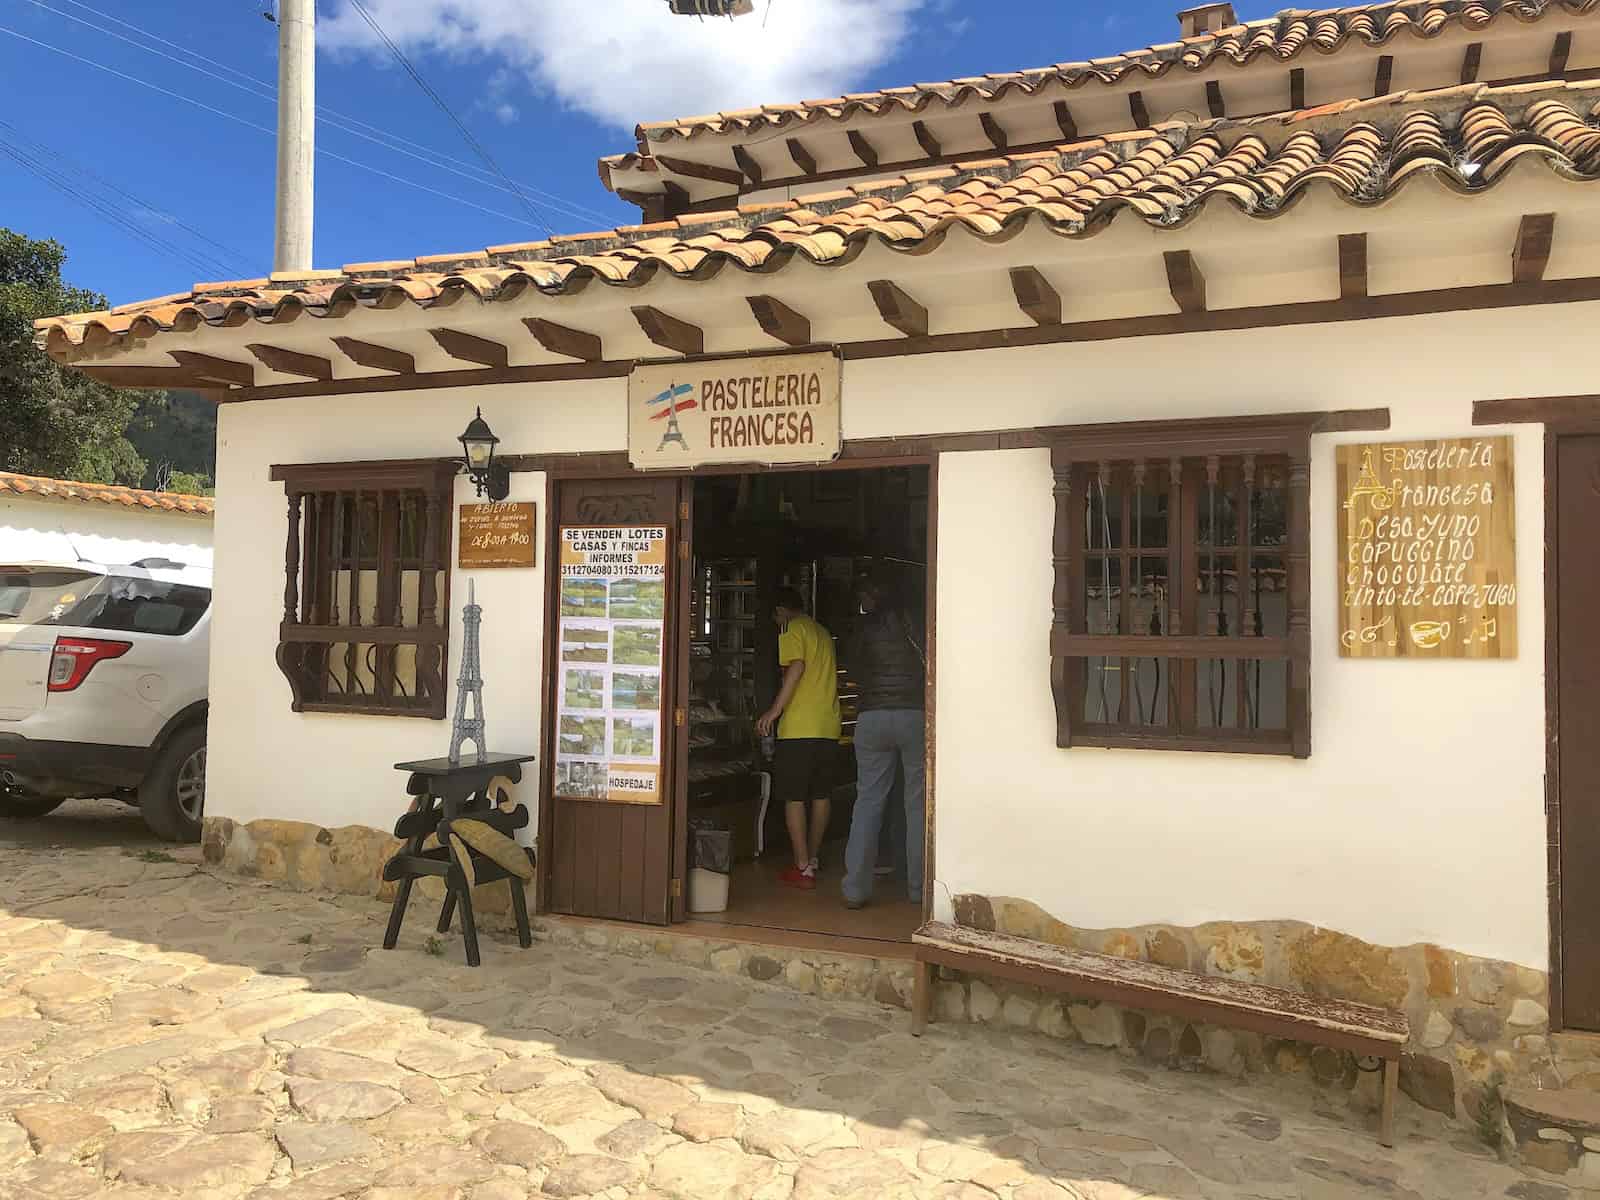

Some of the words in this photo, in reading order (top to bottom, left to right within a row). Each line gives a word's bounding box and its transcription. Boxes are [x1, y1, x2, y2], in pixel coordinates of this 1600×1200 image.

[701, 372, 821, 412] PASTELERIA
[709, 411, 814, 449] FRANCESA
[474, 503, 518, 514] ABIERTO
[566, 530, 579, 540] SE
[582, 529, 622, 540] VENDEN
[628, 529, 664, 539] LOTES
[573, 541, 607, 551] CASAS
[612, 542, 617, 551] Y
[621, 542, 649, 551] FINCAS
[590, 553, 633, 563] INFORMES
[609, 778, 653, 789] HOSPEDAJE
